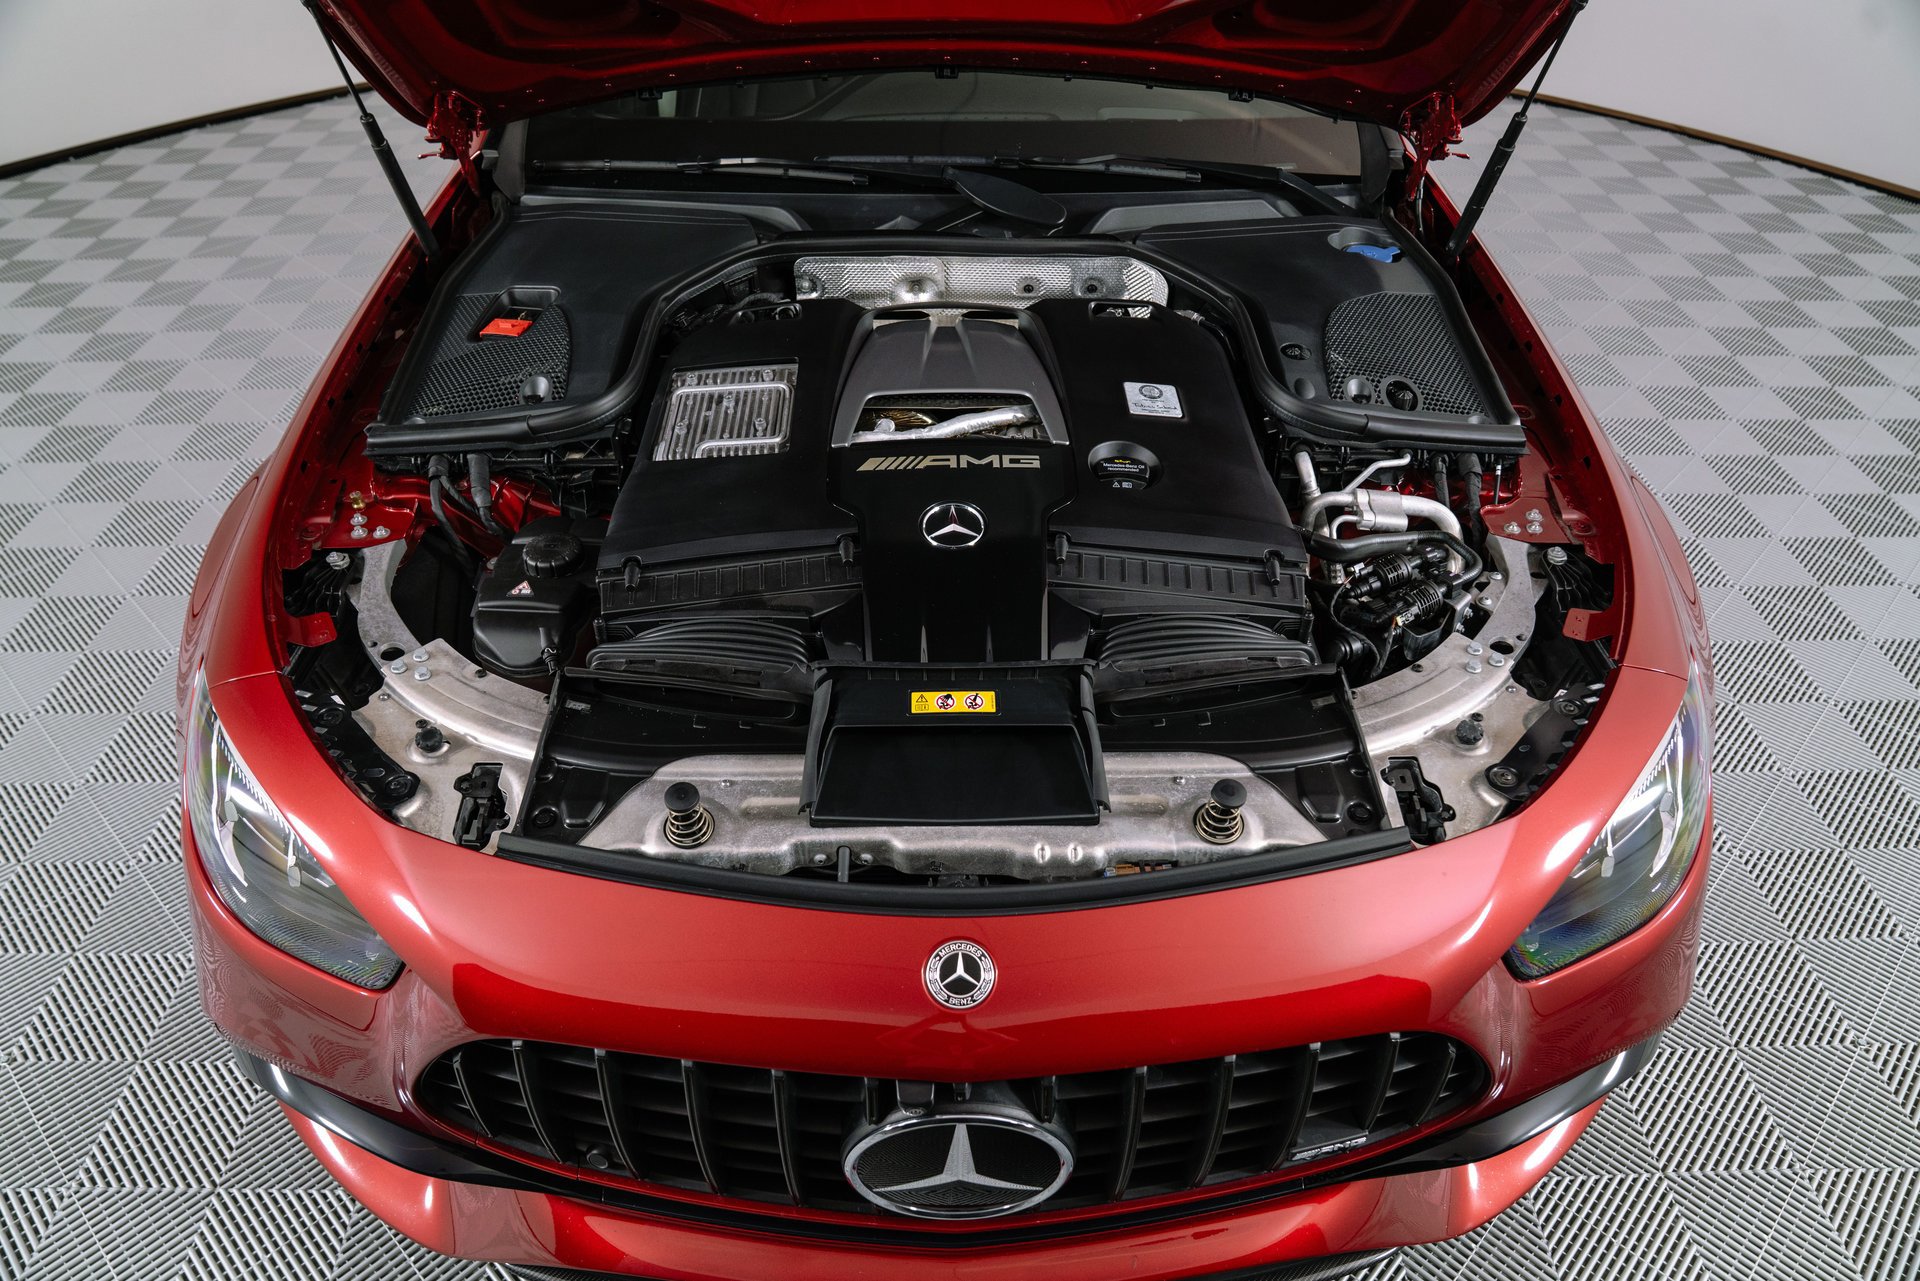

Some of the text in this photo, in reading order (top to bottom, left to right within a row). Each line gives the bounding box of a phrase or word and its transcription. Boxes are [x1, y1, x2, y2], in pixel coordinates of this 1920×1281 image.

[913, 454, 1041, 470] AMG
[938, 943, 983, 957] MERCEDES
[948, 996, 973, 1006] BENZ
